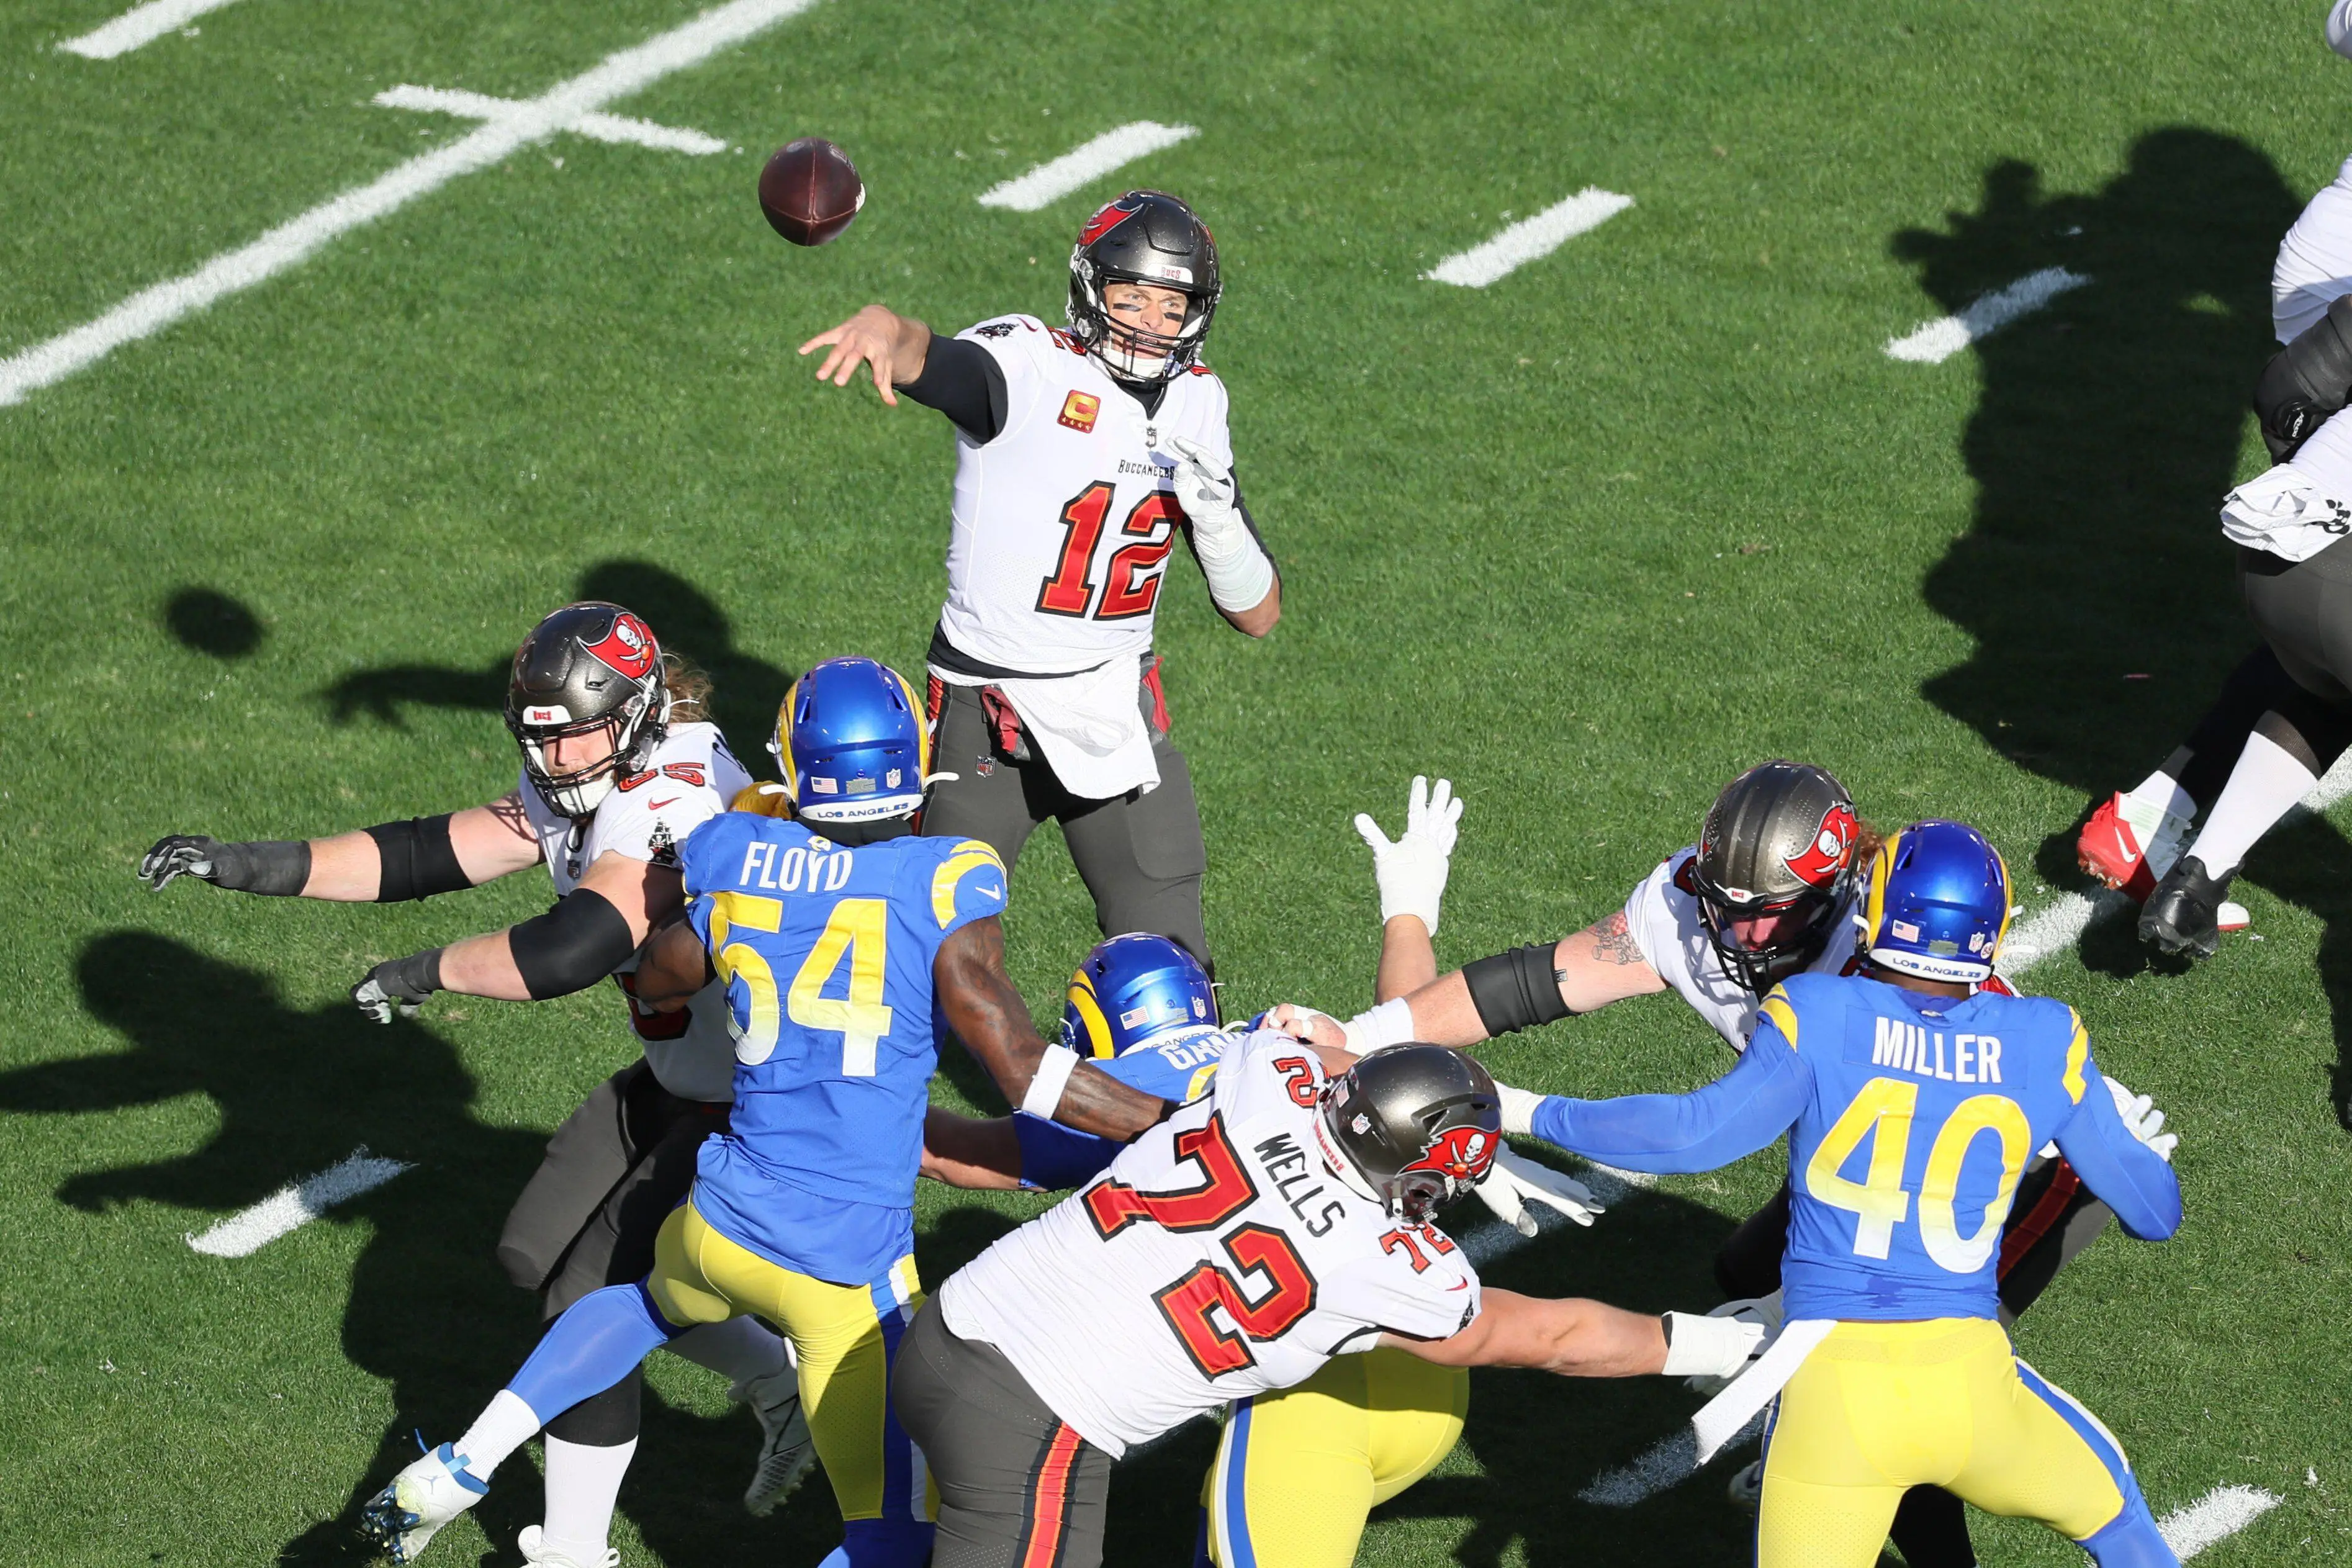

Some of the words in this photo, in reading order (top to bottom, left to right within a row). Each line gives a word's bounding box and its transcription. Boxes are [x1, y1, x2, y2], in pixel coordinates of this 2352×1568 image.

[1064, 394, 1098, 423] C
[1118, 459, 1175, 481] BUCCANEERS
[1035, 480, 1183, 620] 12
[817, 810, 844, 819] LOS
[848, 803, 909, 817] ANGELES
[739, 841, 854, 893] FLOYD
[709, 890, 892, 1076] 54
[1893, 957, 1919, 970] LOS
[1922, 965, 1982, 978] ANGELES
[1872, 1017, 2003, 1084] MILLER
[1253, 1132, 1346, 1238] WELLS
[1805, 1076, 2032, 1274] 40
[1081, 1109, 1318, 1383] 72
[1378, 1220, 1456, 1274] 72
